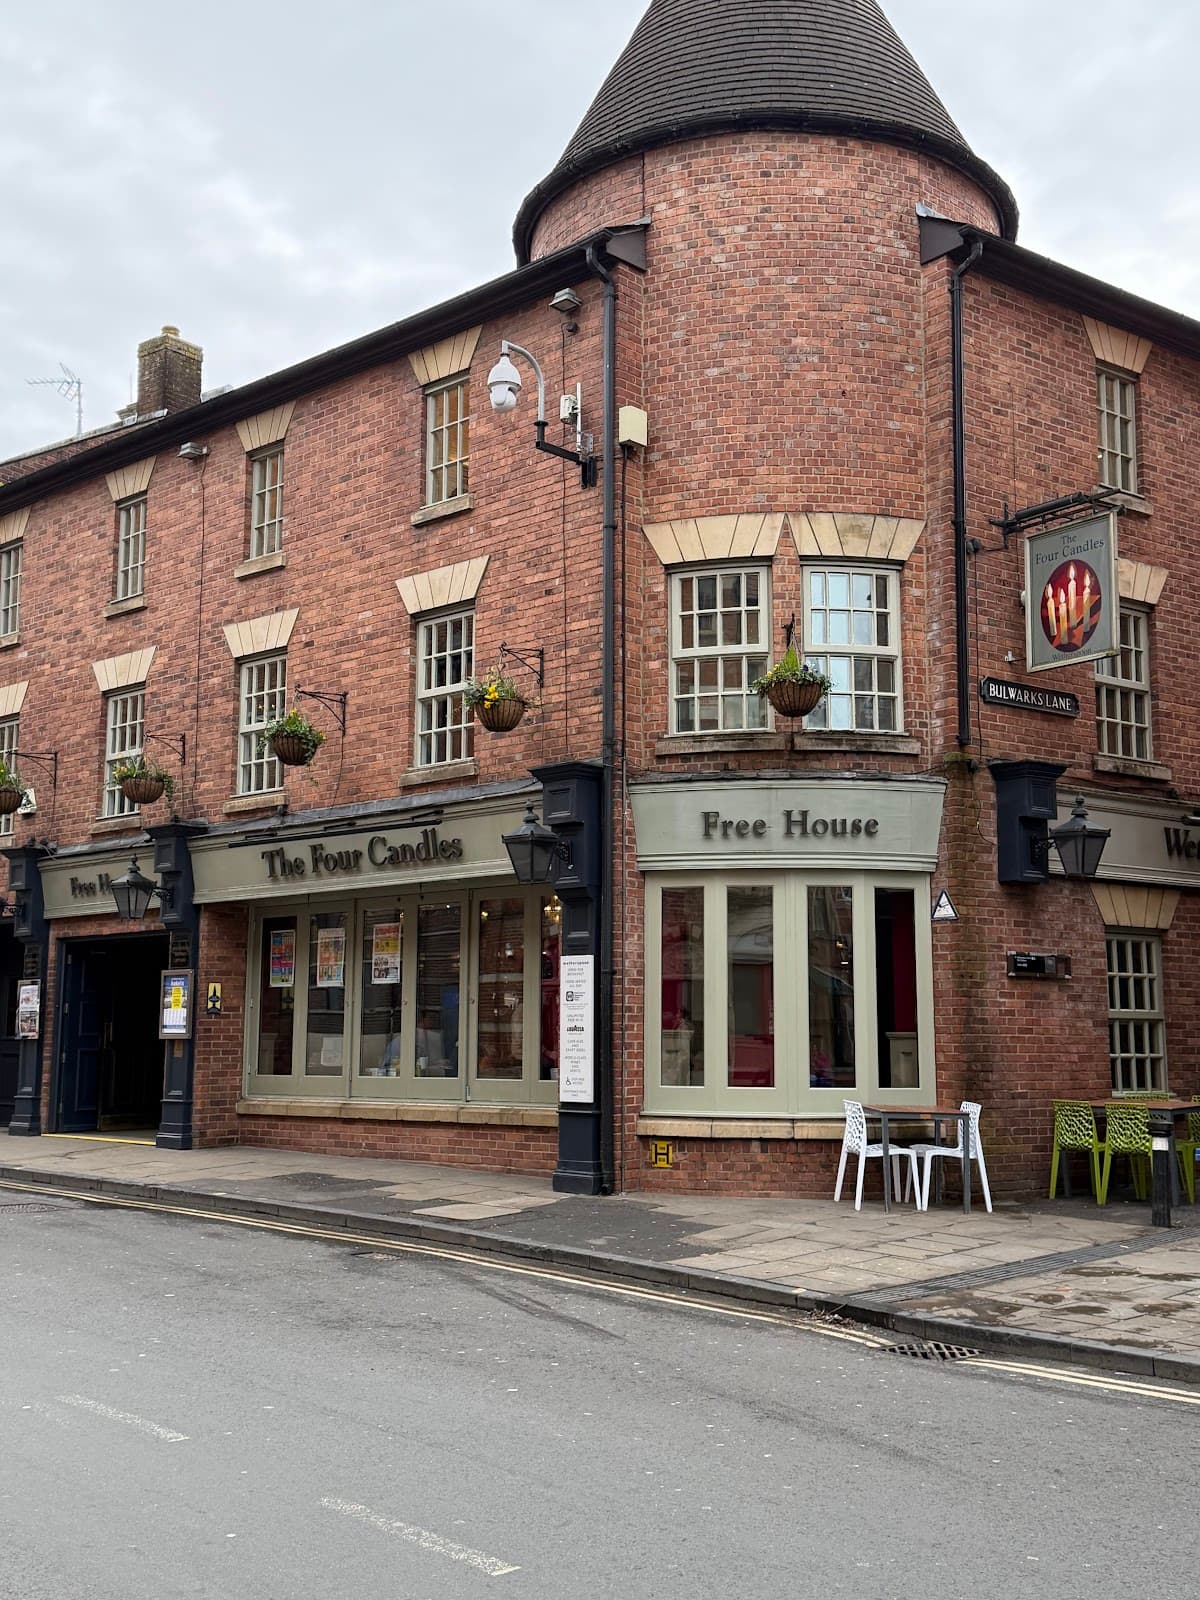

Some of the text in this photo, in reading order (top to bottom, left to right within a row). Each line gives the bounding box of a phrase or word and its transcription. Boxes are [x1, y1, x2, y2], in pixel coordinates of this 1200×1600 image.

[1036, 538, 1105, 565] Four Candles
[1061, 535, 1077, 545] The
[989, 683, 1072, 711] BULWARKS LANE
[700, 809, 879, 837] Free House
[261, 827, 464, 878] The Four Candles
[69, 877, 96, 897] Free
